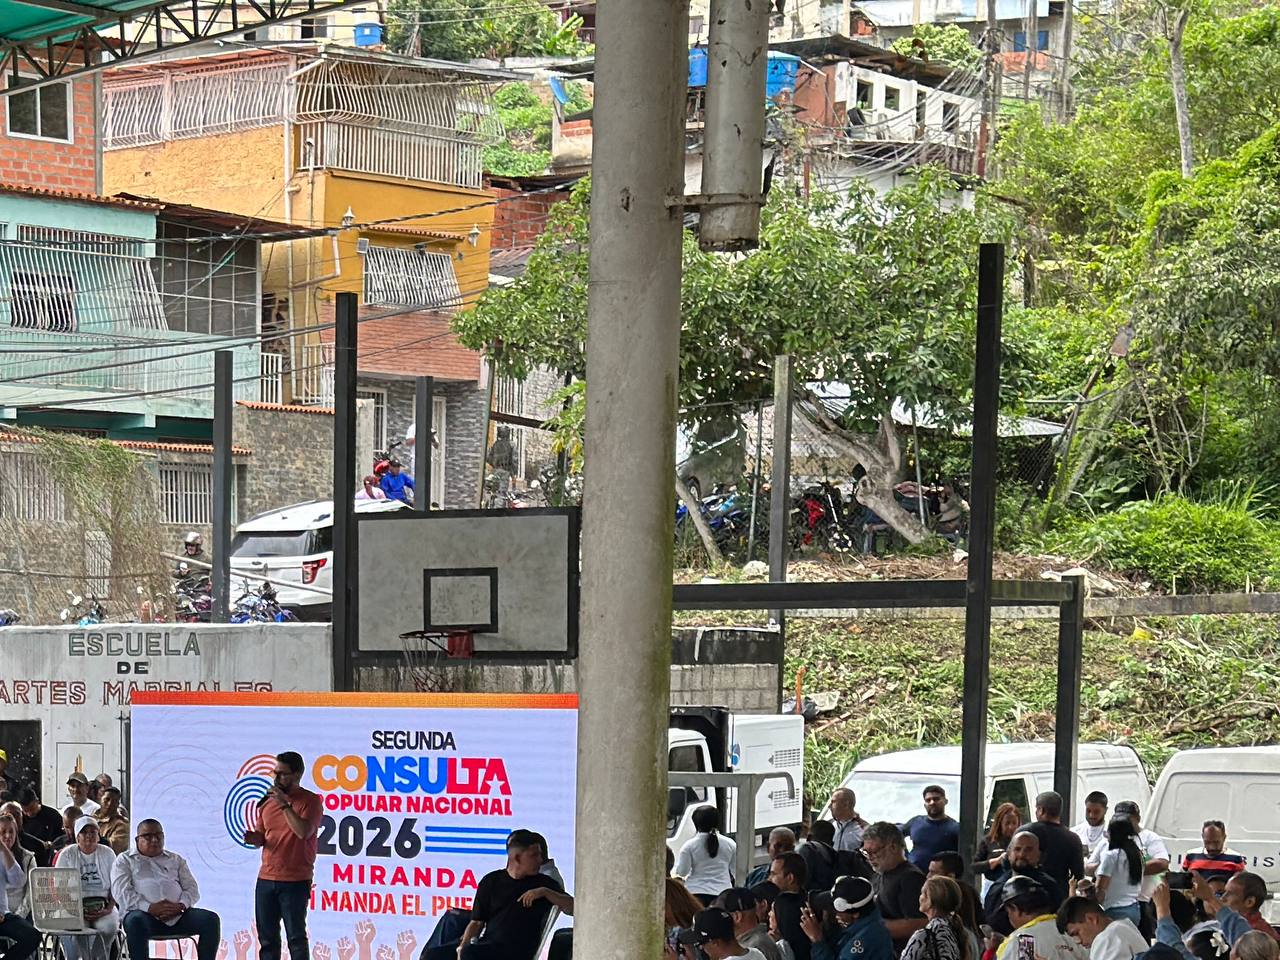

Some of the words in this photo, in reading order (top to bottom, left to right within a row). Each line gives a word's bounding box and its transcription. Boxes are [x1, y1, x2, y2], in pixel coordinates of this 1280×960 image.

[69, 632, 201, 656] ESCUELA
[117, 661, 149, 675] DE
[372, 730, 456, 750] SEGUNDA
[312, 754, 512, 795] CONSULTA
[317, 793, 402, 813] OPULAR
[407, 796, 512, 816] NACIONAL
[316, 815, 421, 859] 2026
[333, 863, 478, 890] MIRANDA
[321, 890, 397, 915] MANDA
[402, 894, 426, 916] EL
[432, 896, 473, 917] PUE
